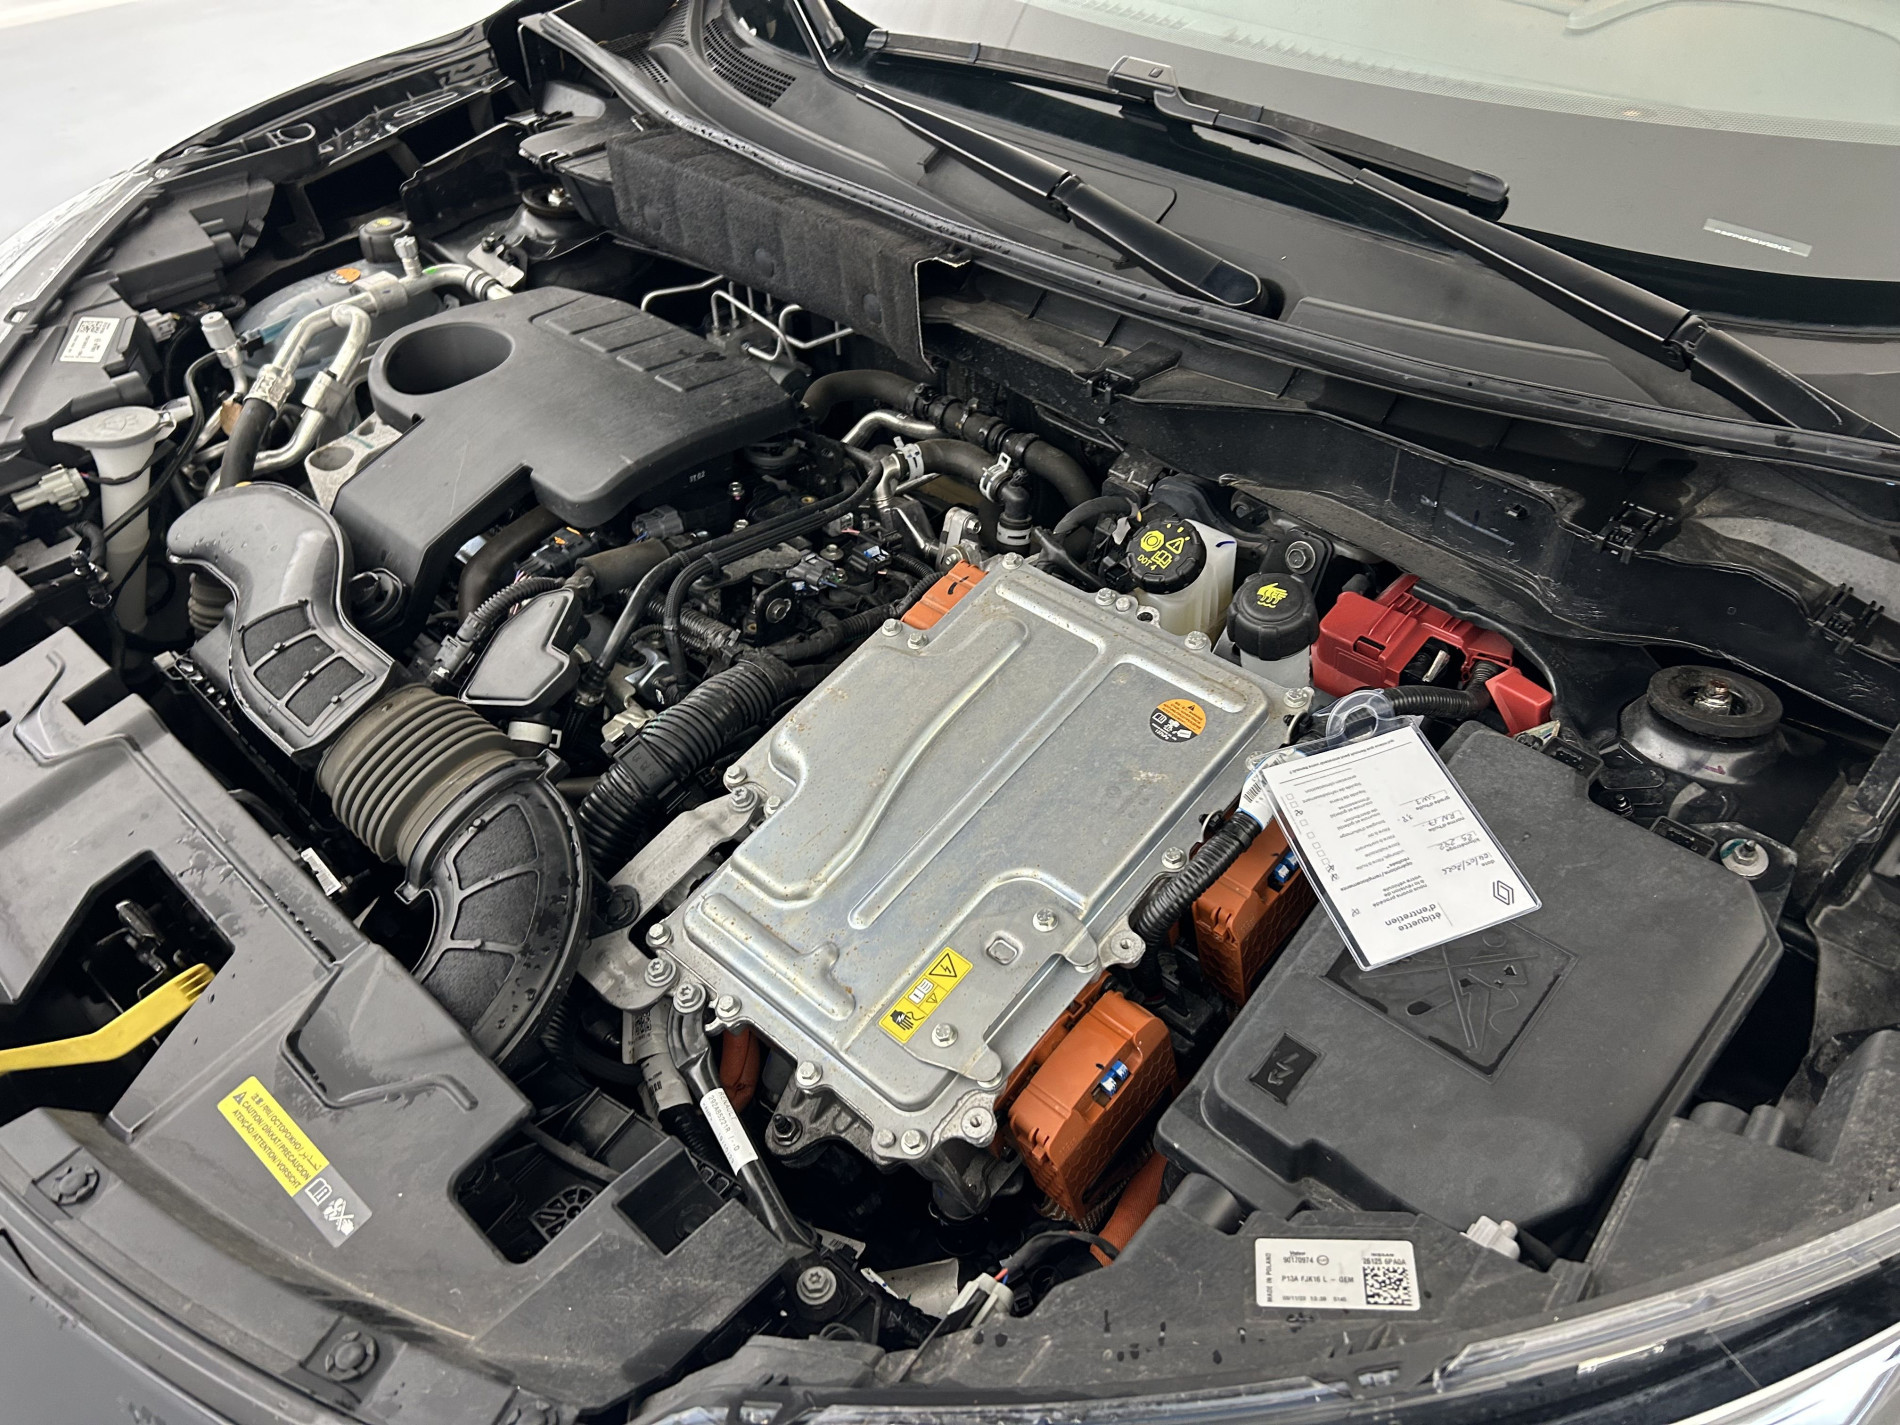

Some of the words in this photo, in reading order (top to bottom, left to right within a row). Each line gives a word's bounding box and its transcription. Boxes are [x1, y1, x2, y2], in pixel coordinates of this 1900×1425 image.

[1137, 554, 1152, 567] DOT
[1384, 903, 1436, 926] d'entretien
[1397, 911, 1441, 931] étiquette
